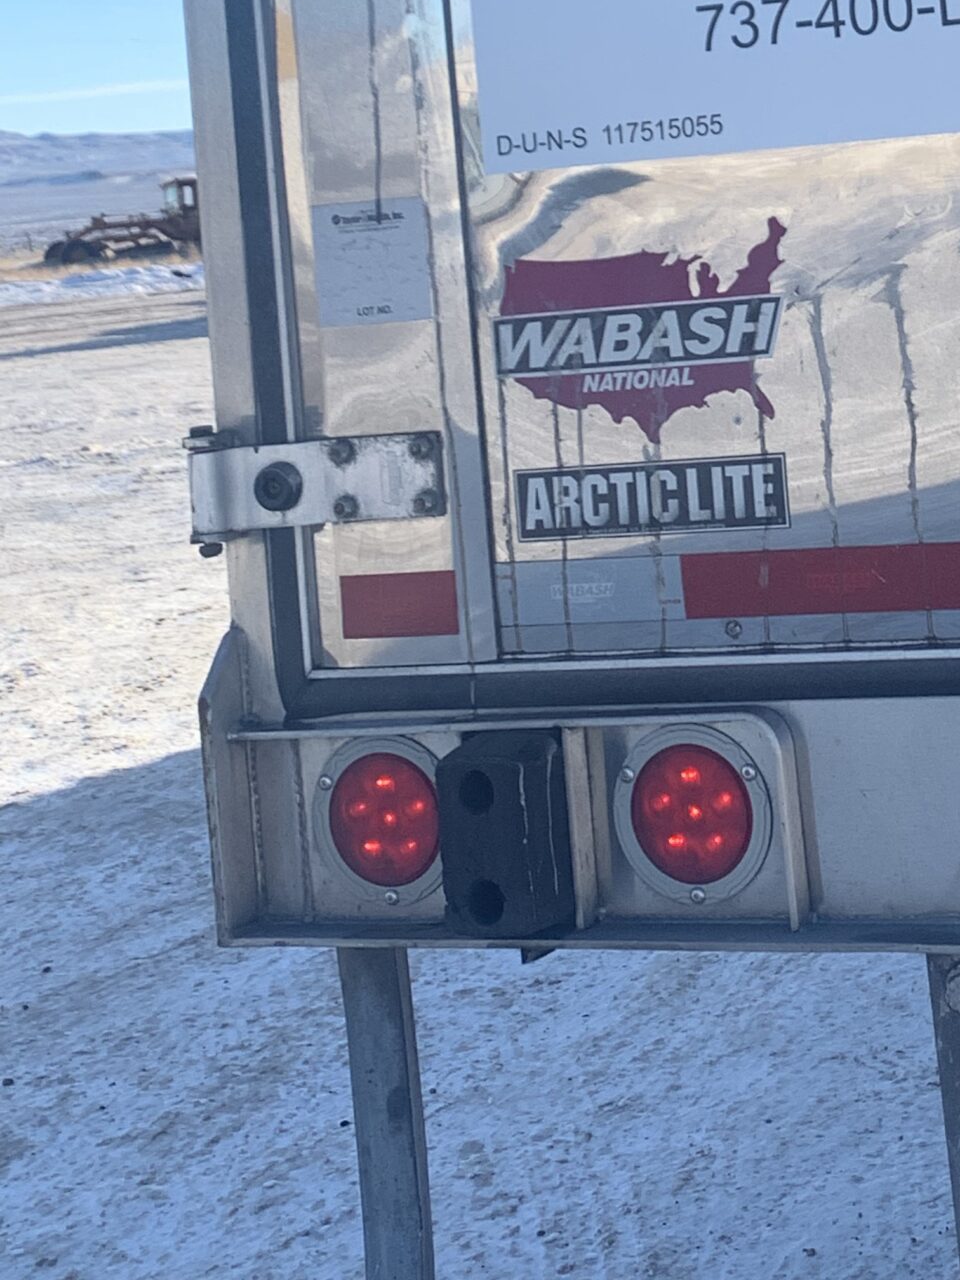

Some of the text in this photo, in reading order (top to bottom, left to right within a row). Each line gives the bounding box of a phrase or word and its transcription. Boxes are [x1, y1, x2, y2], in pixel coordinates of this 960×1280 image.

[497, 114, 724, 156] D-U-N-S 117515055
[501, 302, 775, 369] WABASH
[583, 368, 694, 393] NATIONAL
